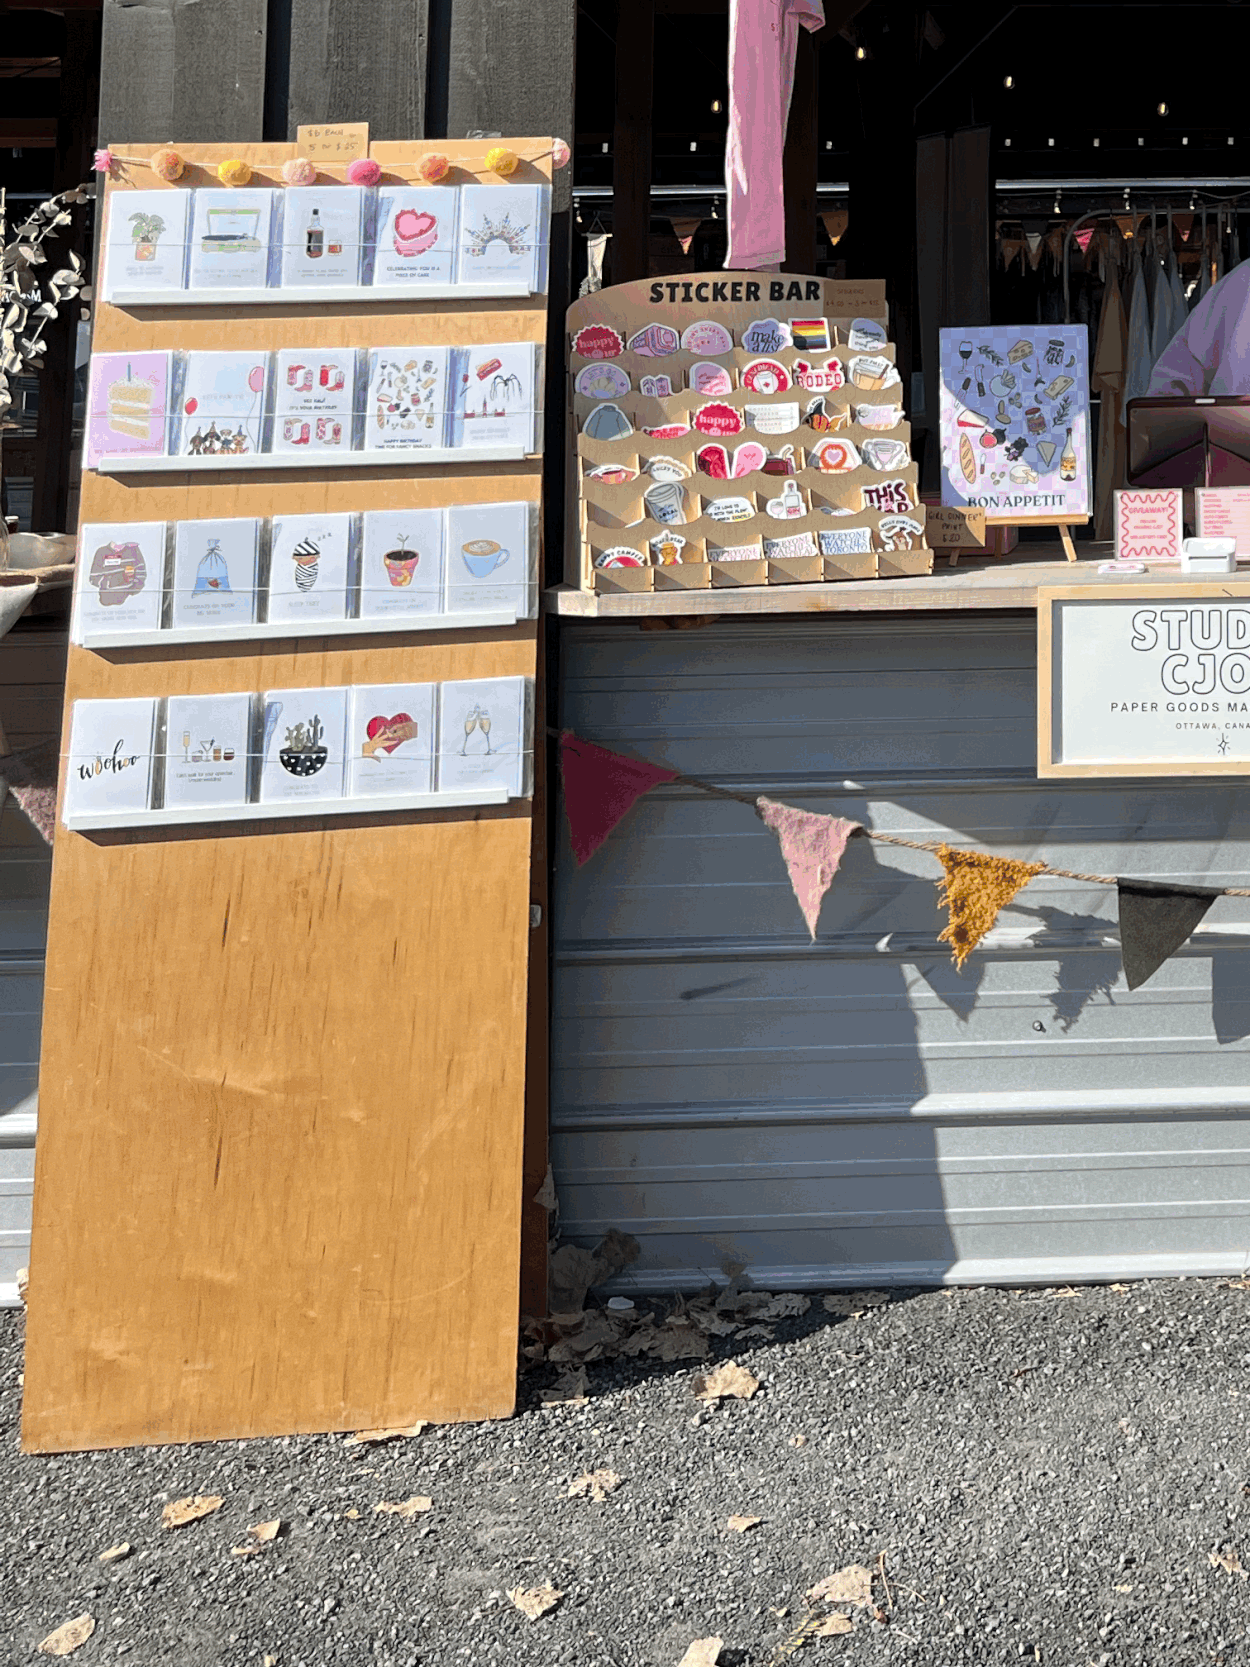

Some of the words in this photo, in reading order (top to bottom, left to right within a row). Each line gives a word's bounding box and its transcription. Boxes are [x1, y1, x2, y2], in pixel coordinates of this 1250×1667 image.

[650, 282, 760, 303] STICKER
[769, 280, 821, 302] BAR
[578, 336, 615, 348] happy
[751, 329, 785, 343] make
[752, 342, 760, 352] a
[797, 372, 843, 389] RODEO
[699, 414, 737, 427] happy
[968, 496, 999, 508] BON
[1003, 494, 1066, 508] APPETIT
[928, 513, 945, 521] GIRL
[824, 544, 868, 554] TORONTO
[616, 550, 645, 563] CAMPER
[1110, 702, 1159, 713] PAPER
[1166, 702, 1220, 713] GOODS
[1175, 722, 1221, 731] OTTAWA,
[77, 738, 141, 780] woohoo
